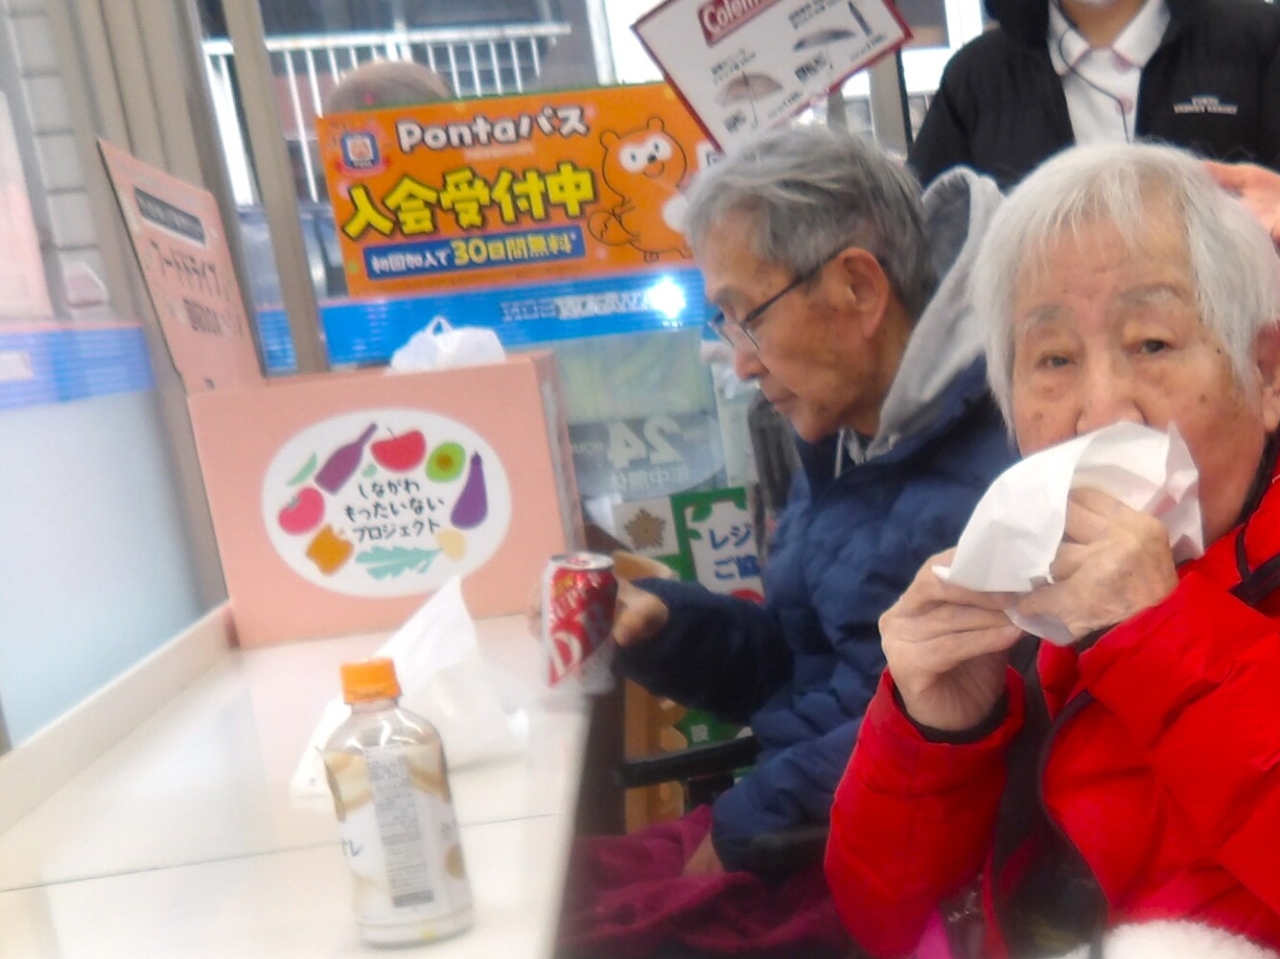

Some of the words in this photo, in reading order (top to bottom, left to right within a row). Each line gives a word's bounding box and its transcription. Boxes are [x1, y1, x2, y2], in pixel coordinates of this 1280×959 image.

[395, 104, 590, 153] Pontaパス
[342, 160, 597, 241] 入会受付中
[358, 477, 420, 500] しながわ
[344, 497, 445, 523] もったいない
[352, 517, 442, 543] プロジェクト
